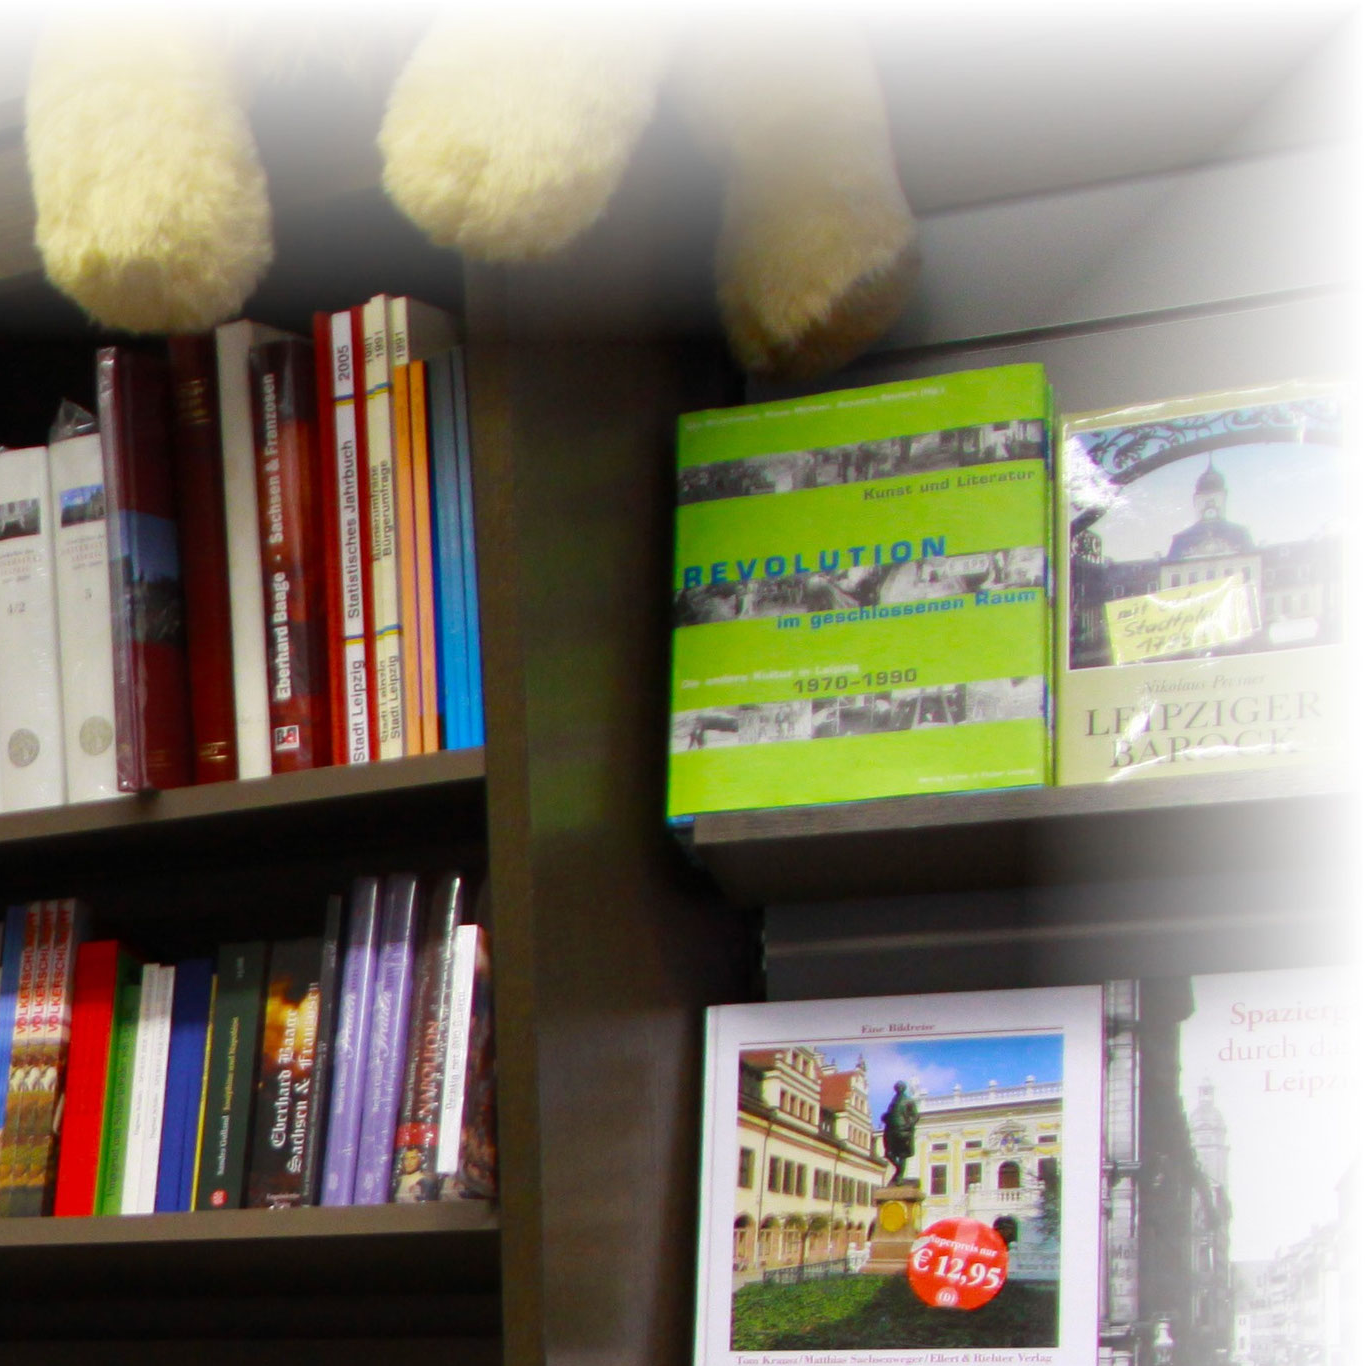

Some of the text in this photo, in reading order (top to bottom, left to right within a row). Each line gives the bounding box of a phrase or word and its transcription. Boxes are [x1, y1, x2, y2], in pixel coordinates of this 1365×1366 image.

[395, 330, 406, 360] 1991
[863, 470, 1035, 501] Kunst und Literatur
[337, 344, 367, 764] Stadt Leipzig Statistisches Jahrbuch 2005
[374, 330, 401, 739] Stadt Leipzig Bürgerumfrage 1991
[683, 536, 947, 590] REVOLUTION
[777, 590, 1035, 629] im geschlossenen Raum
[1086, 691, 1322, 736] LEIPZIGER
[1111, 728, 1298, 769] BAROCK
[1218, 1037, 1297, 1062] durch
[914, 1248, 1001, 1289] € 12,95
